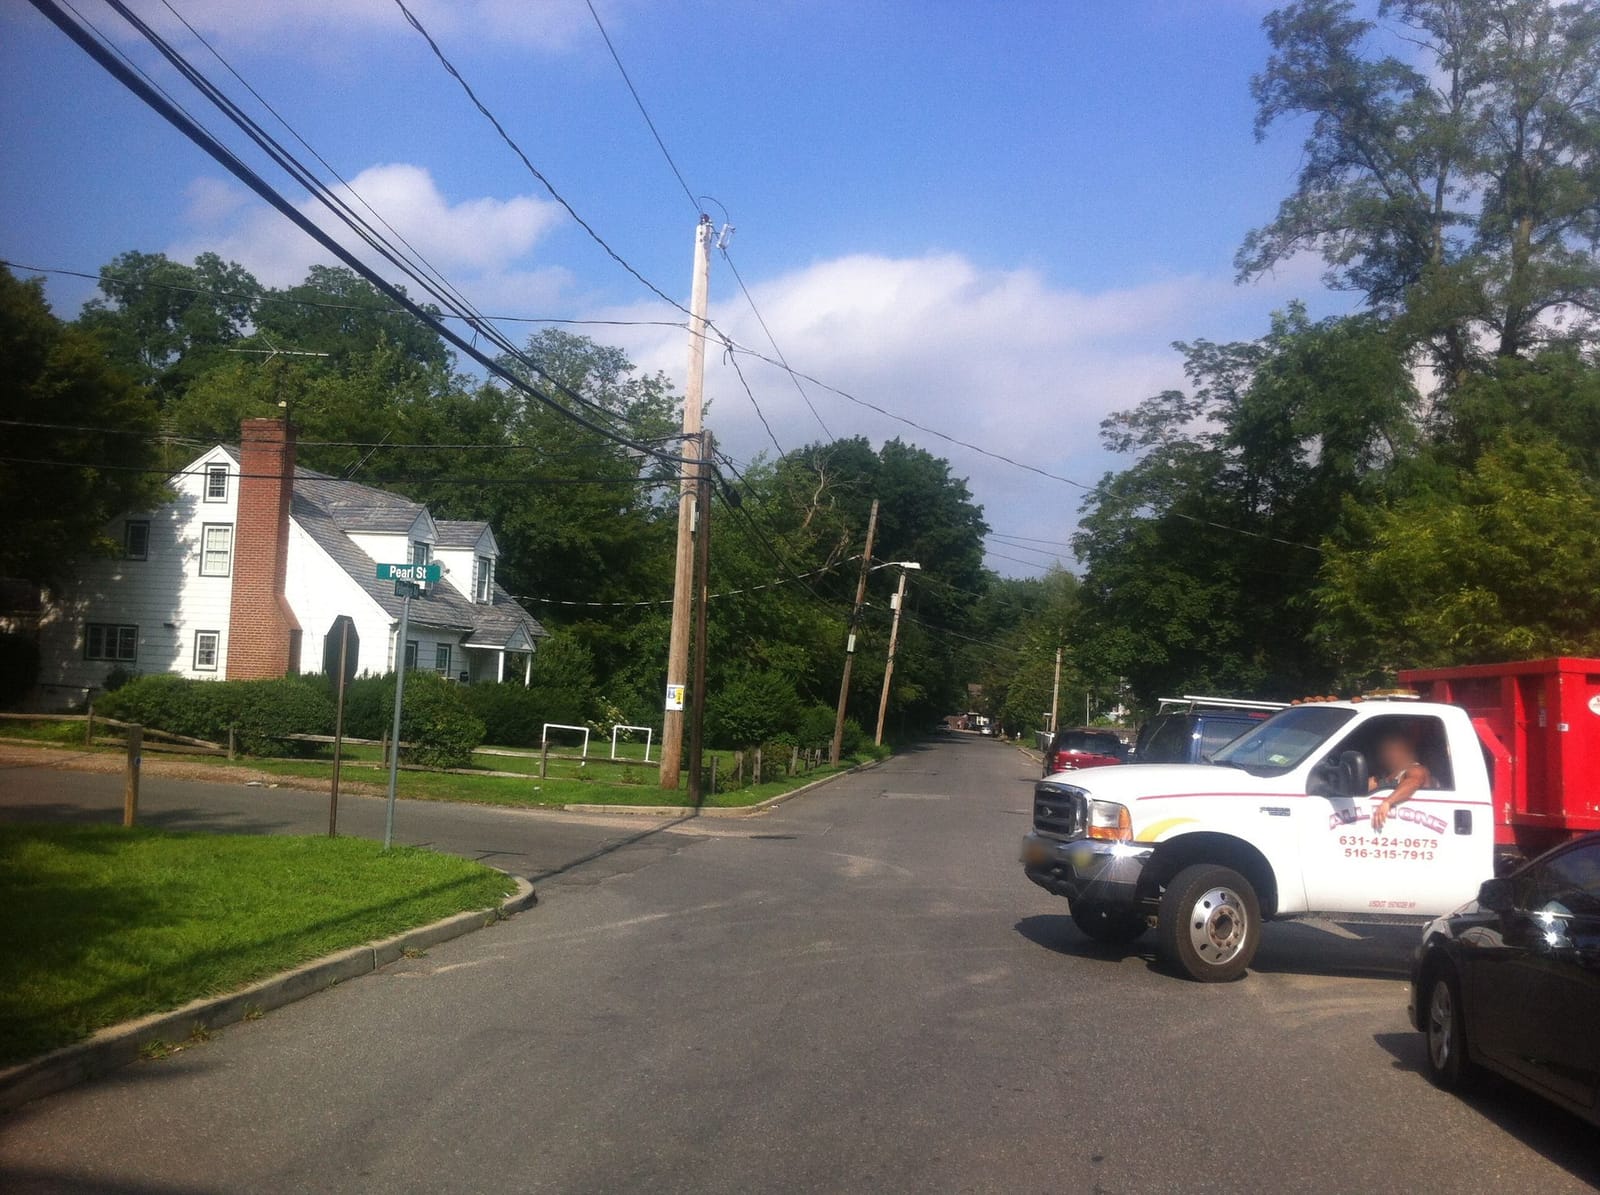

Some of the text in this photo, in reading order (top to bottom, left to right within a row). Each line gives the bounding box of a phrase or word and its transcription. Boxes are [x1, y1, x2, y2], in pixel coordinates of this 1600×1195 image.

[389, 566, 427, 579] Pearl St
[1329, 806, 1370, 830] ALL
[1398, 807, 1448, 834] ONE
[1339, 835, 1438, 849] 631-424-0675
[1344, 849, 1434, 861] 516-315-7913
